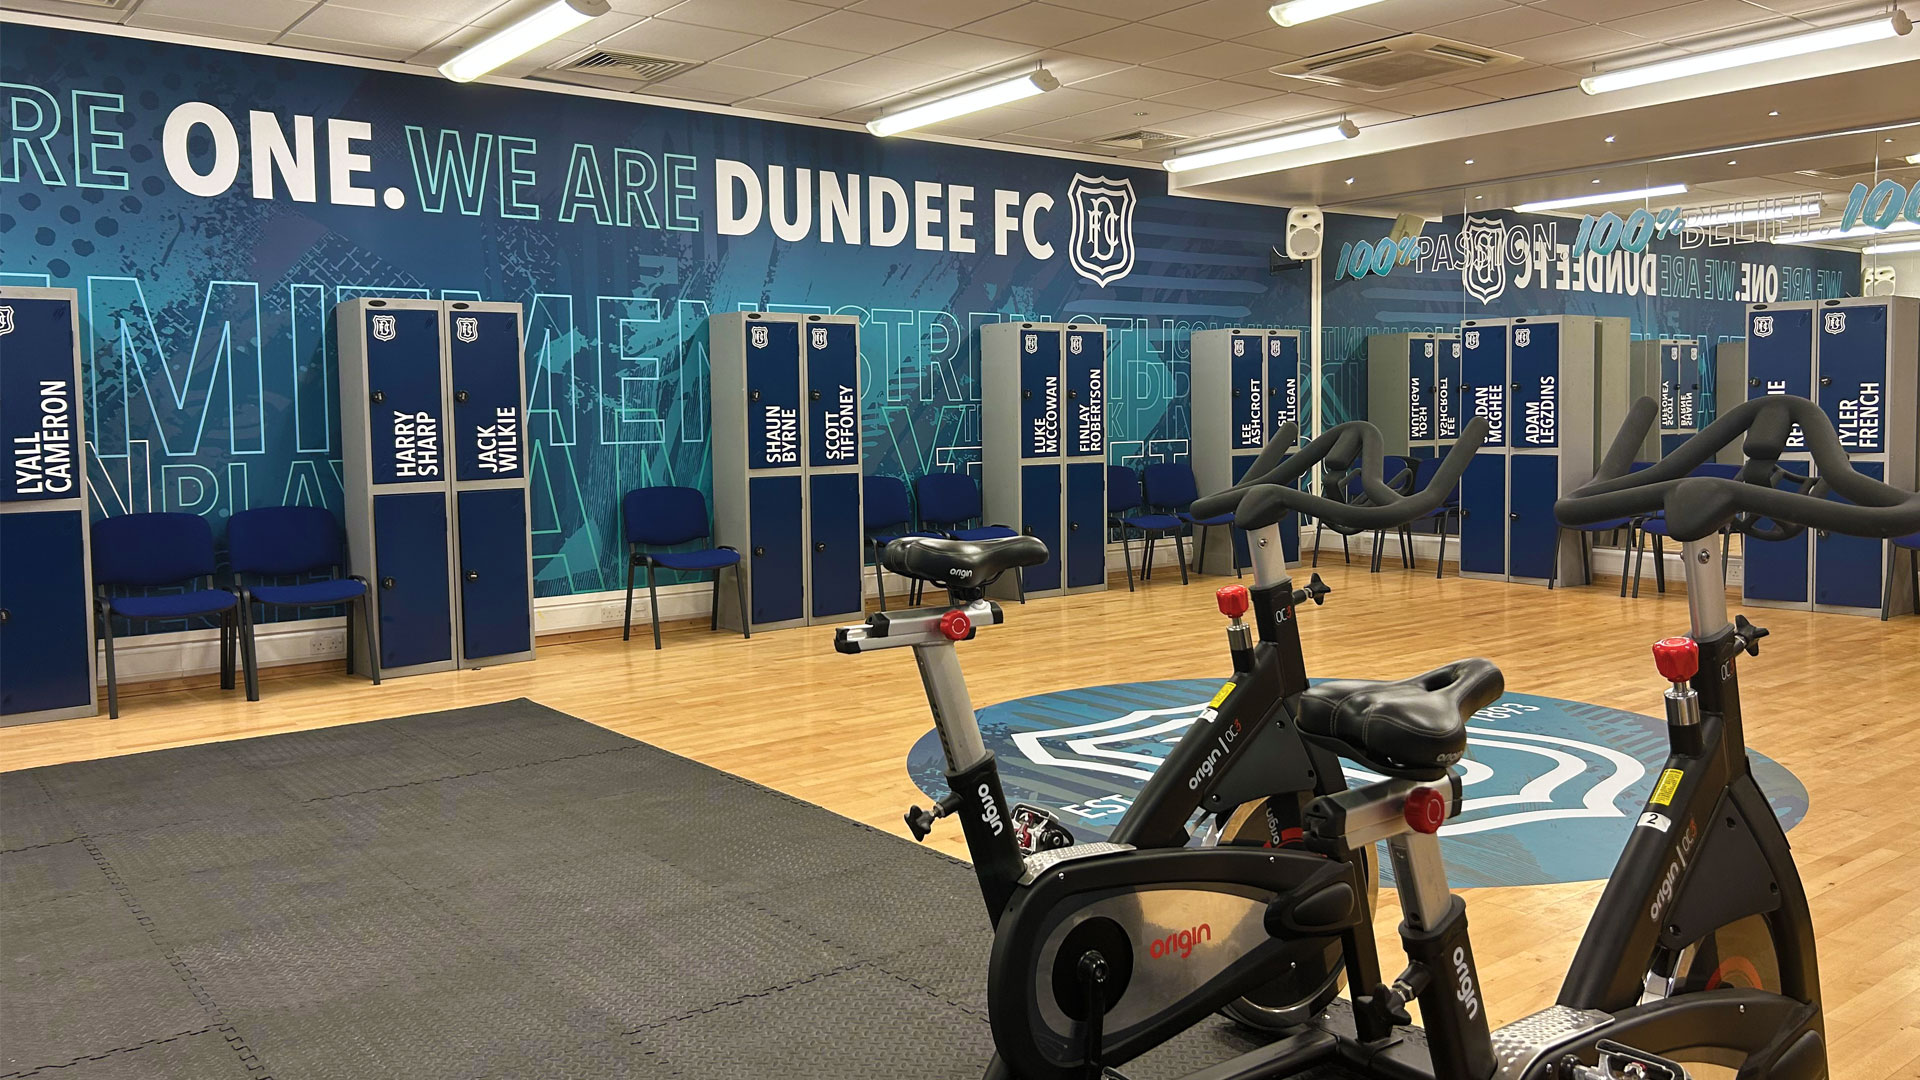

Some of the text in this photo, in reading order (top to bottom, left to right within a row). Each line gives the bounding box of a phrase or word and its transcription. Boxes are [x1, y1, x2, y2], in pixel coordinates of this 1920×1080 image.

[162, 101, 406, 210] ONE.
[406, 125, 541, 222] WE
[559, 143, 701, 233] ARE
[715, 159, 976, 254] DUNDEE
[994, 189, 1055, 261] FC
[1335, 236, 1422, 281] 100%
[1415, 222, 1569, 274] PASSION.
[1573, 207, 1687, 258] 100%
[40, 381, 72, 493] CAMERON
[766, 405, 781, 463] SHAUN
[781, 409, 797, 462] BYRNE
[825, 411, 840, 460] SCOTT
[839, 385, 855, 460] TIFFONEY
[1034, 417, 1046, 453] LUKE
[1046, 376, 1058, 452] MCCOWAN
[1079, 404, 1090, 452] FINLAY
[1090, 369, 1101, 452] ROBERTSON
[1242, 423, 1251, 445] LEE
[1250, 378, 1261, 445] ASHCROFT
[1287, 378, 1296, 443] LLIGAN
[1488, 384, 1502, 442] MCGHEE
[1526, 400, 1540, 444] ADAM
[1540, 375, 1555, 444] LEGZDINS
[1839, 399, 1858, 446] TYLER
[1859, 382, 1879, 448] FRENCH
[14, 431, 43, 494] LYALL
[394, 411, 417, 477] HARRY
[416, 411, 438, 477] SHARP
[477, 425, 498, 473] JACK
[497, 407, 518, 472] WILKIE
[949, 568, 973, 580] origin
[1471, 702, 1541, 722] 1893
[1188, 747, 1222, 791] origin
[978, 783, 1004, 837] origin
[1646, 813, 1659, 825] 2
[1650, 861, 1679, 922] origin
[1149, 923, 1212, 960] origin
[1452, 946, 1478, 1020] origin
